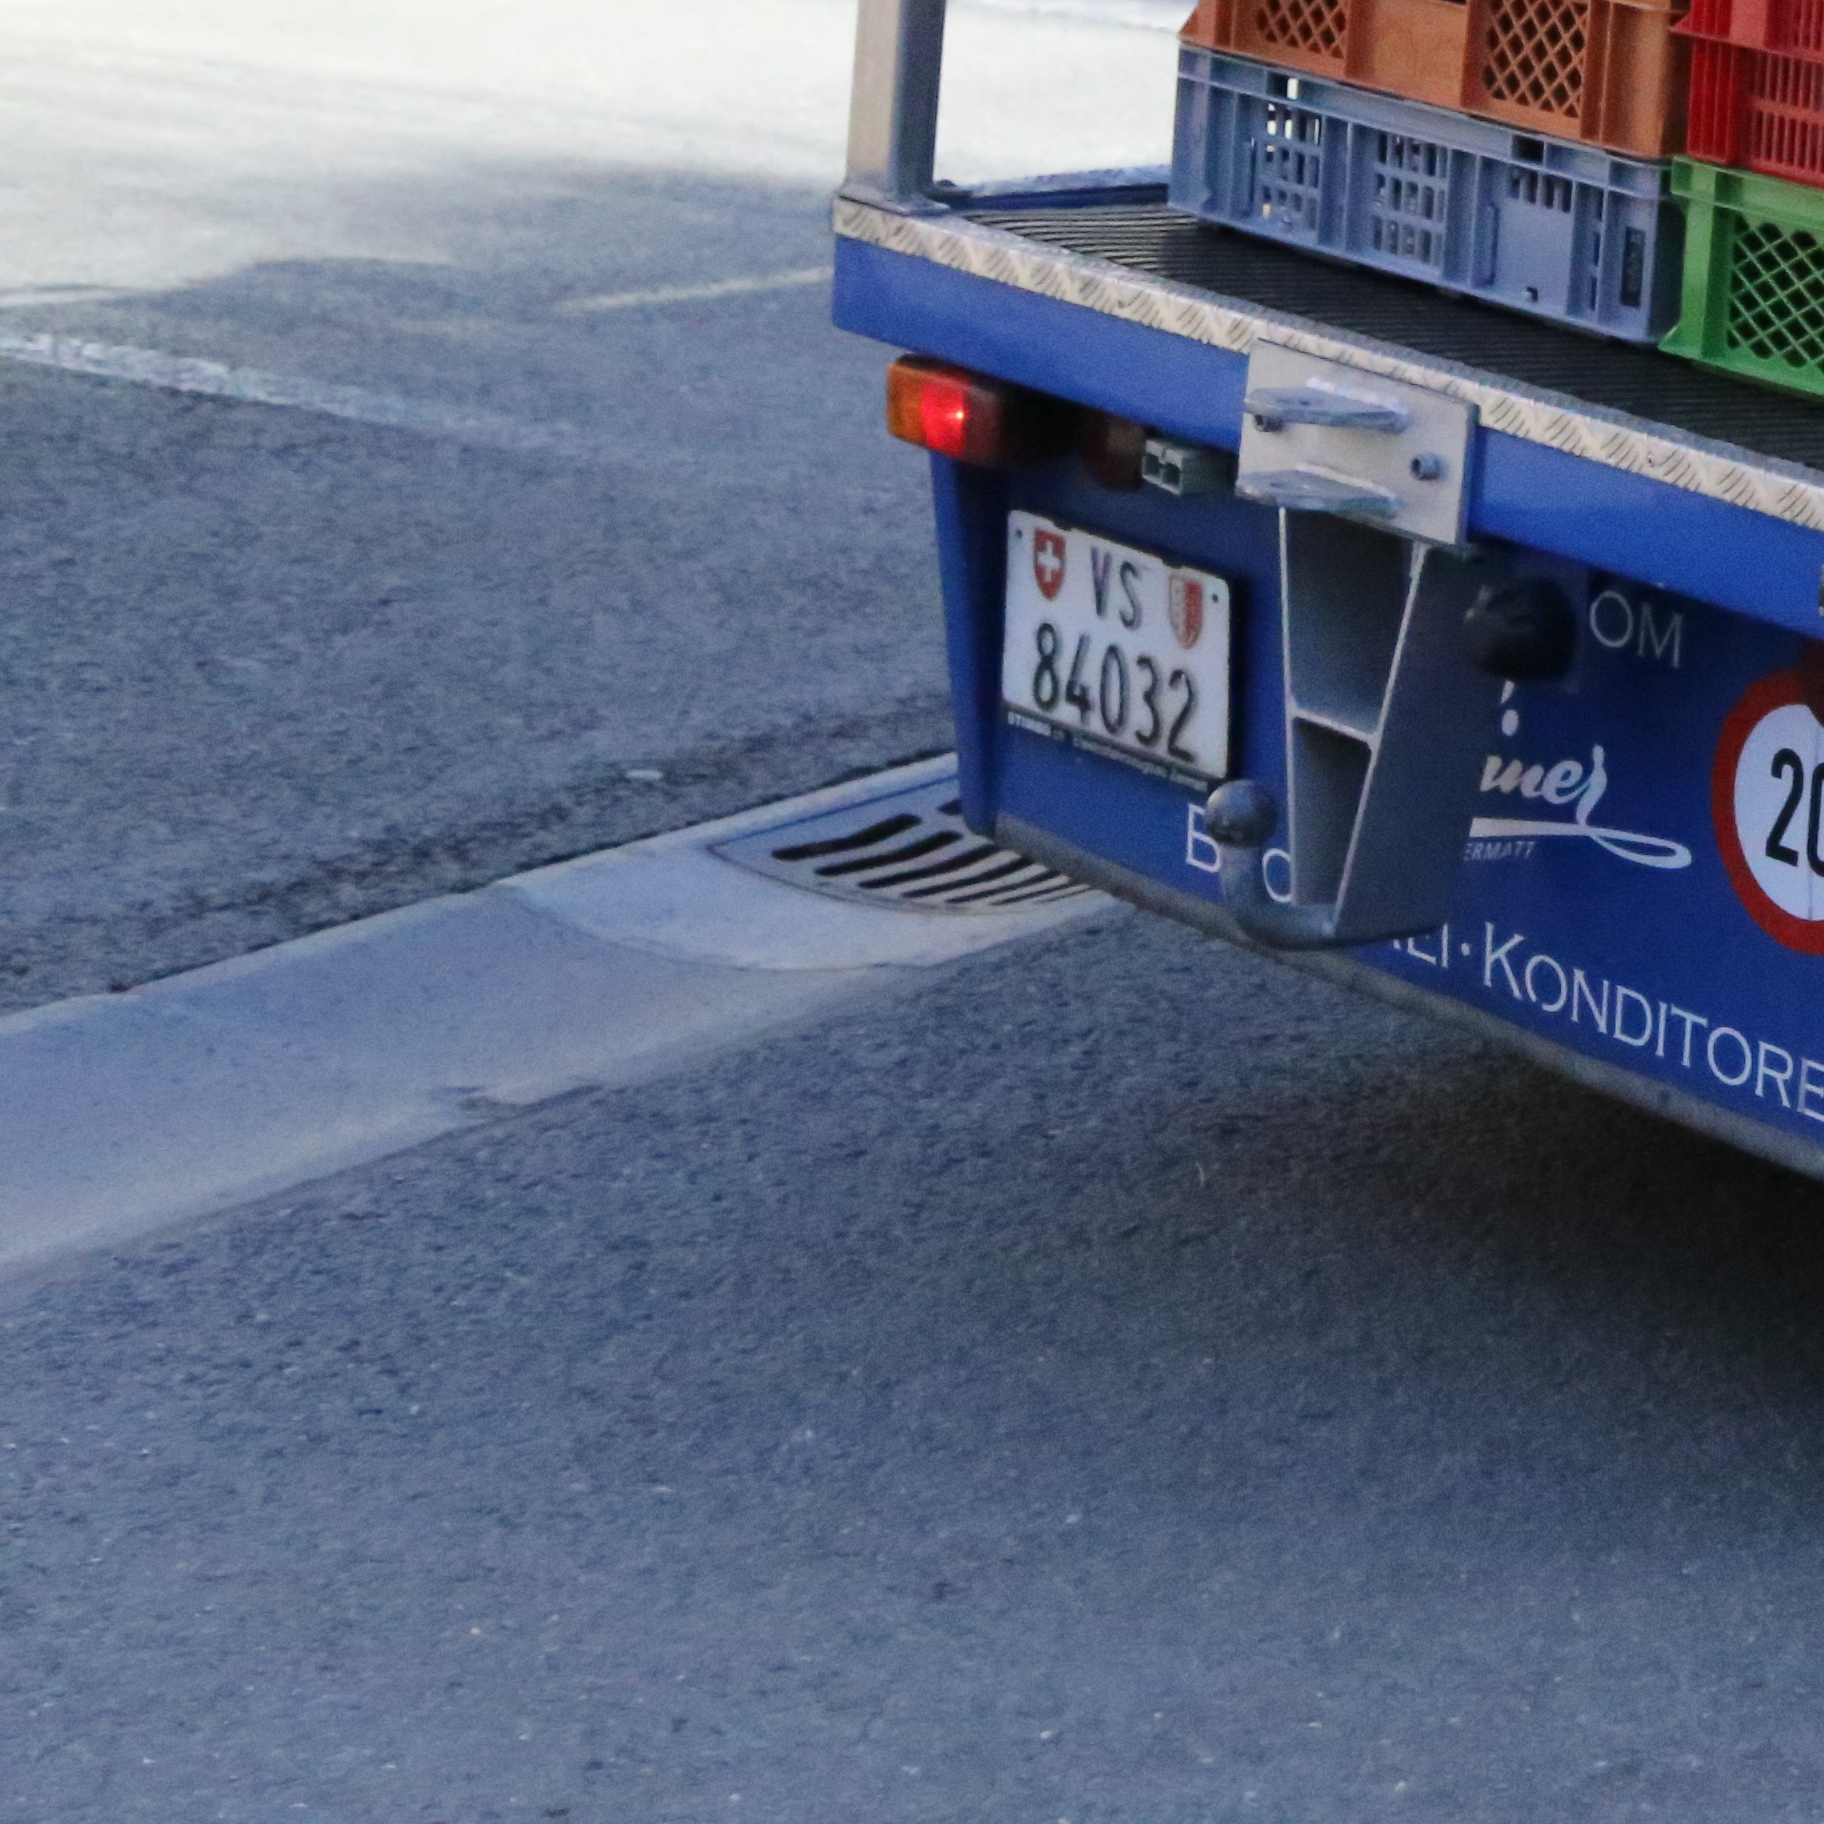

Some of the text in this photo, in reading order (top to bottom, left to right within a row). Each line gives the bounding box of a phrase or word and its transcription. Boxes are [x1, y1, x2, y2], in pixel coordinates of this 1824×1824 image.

[1090, 545, 1141, 631] VS
[1033, 623, 1196, 764] 84032
[1463, 838, 1538, 865] ERMATT
